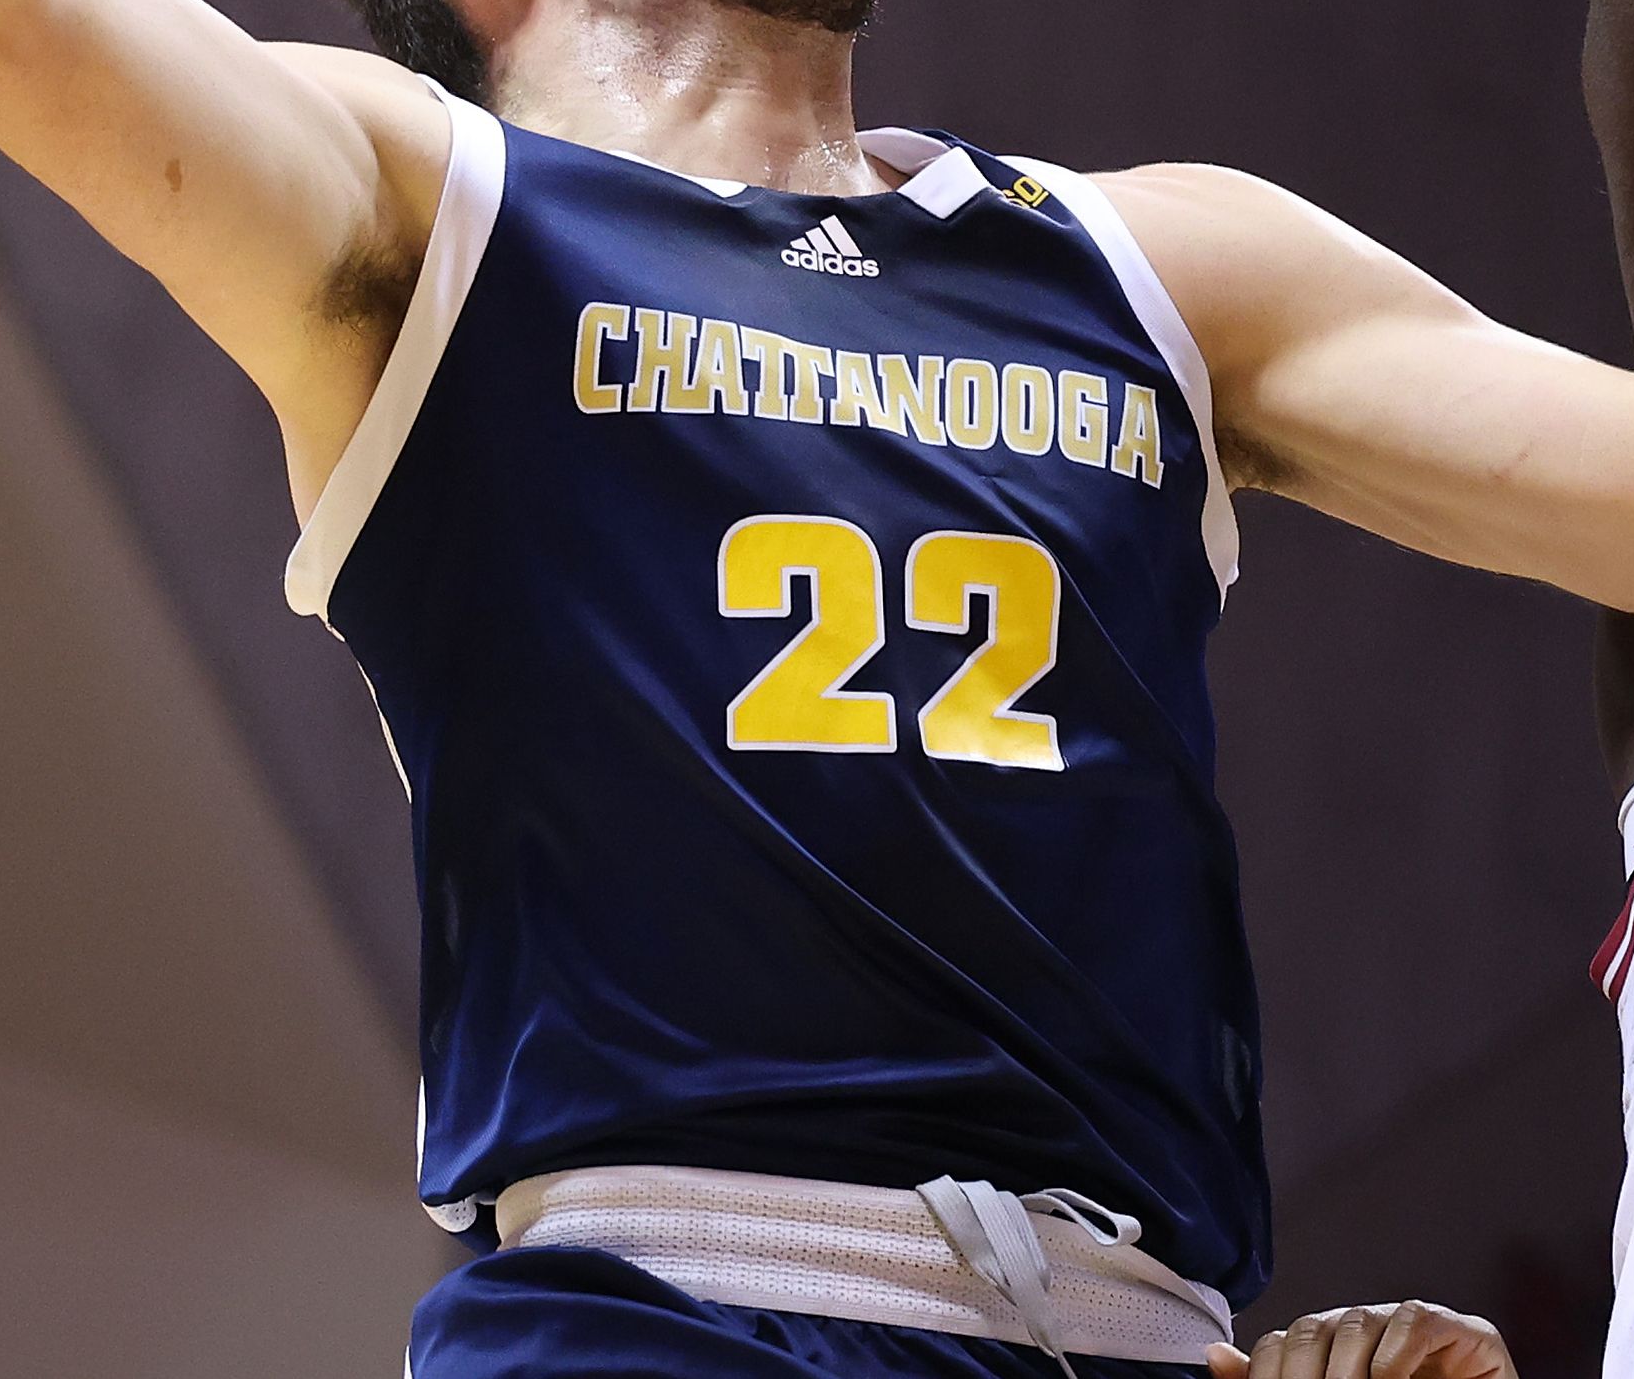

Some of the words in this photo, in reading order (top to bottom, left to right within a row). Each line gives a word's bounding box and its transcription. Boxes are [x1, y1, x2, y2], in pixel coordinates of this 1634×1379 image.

[781, 249, 880, 277] adidas
[574, 302, 1165, 490] CHATTANOOGA
[717, 514, 1065, 772] 22
